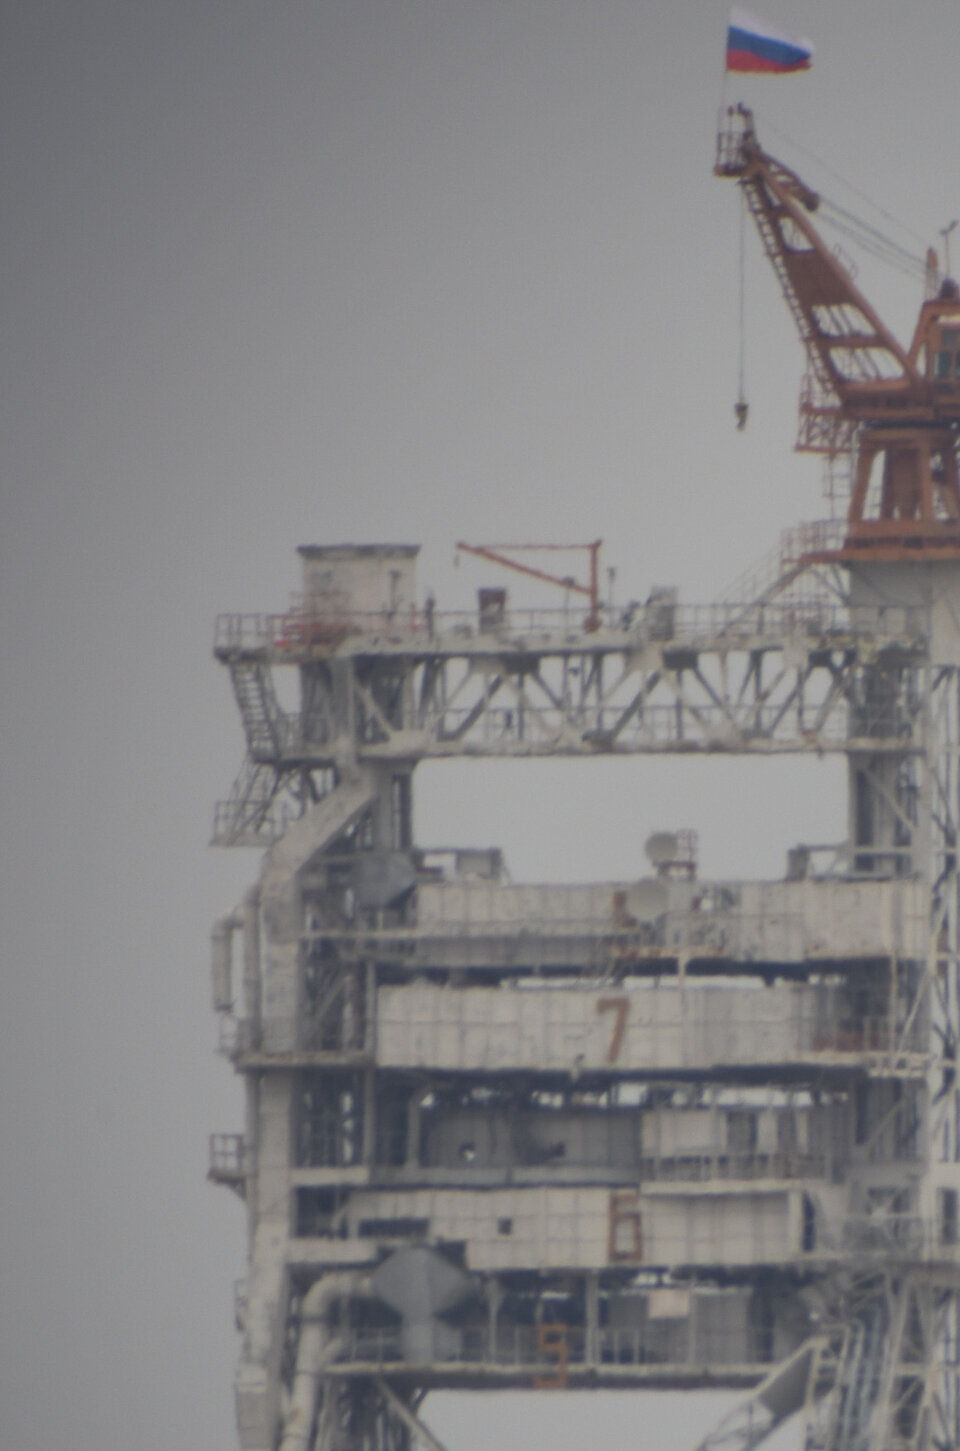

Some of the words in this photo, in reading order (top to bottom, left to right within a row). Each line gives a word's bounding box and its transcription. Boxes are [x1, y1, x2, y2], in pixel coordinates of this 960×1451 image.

[596, 997, 630, 1064] 7
[608, 1192, 642, 1262] 6
[533, 1323, 567, 1389] 5
